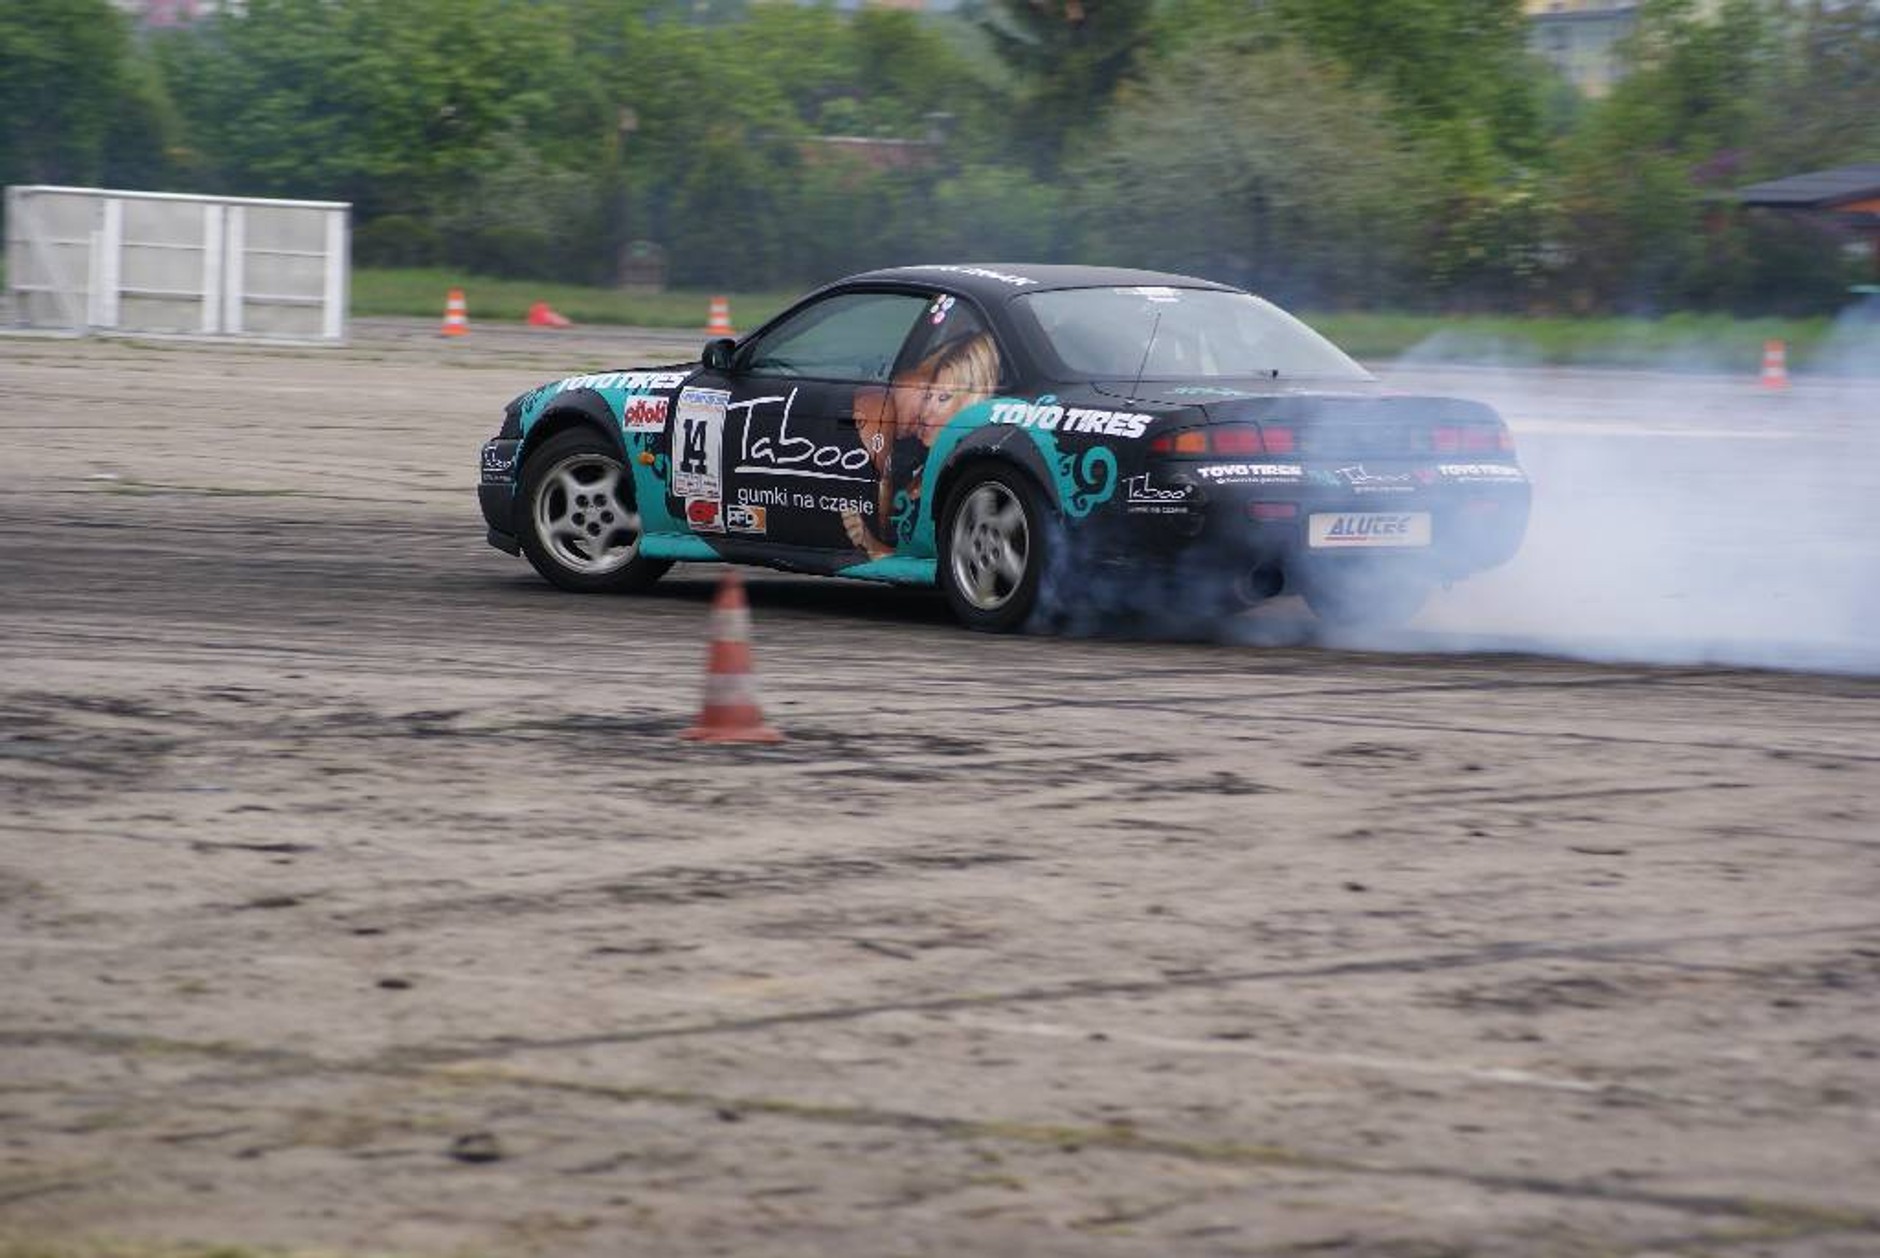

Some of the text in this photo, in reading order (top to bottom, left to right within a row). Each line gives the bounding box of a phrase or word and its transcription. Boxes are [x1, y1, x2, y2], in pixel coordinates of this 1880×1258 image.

[726, 387, 870, 469] Taboo
[990, 403, 1153, 438] TOYO TIRES
[680, 419, 708, 474] 14
[1122, 472, 1186, 498] Taboo
[1197, 464, 1249, 478] TOYO
[738, 487, 788, 506] gumki
[793, 493, 815, 507] na
[818, 495, 874, 515] czasie
